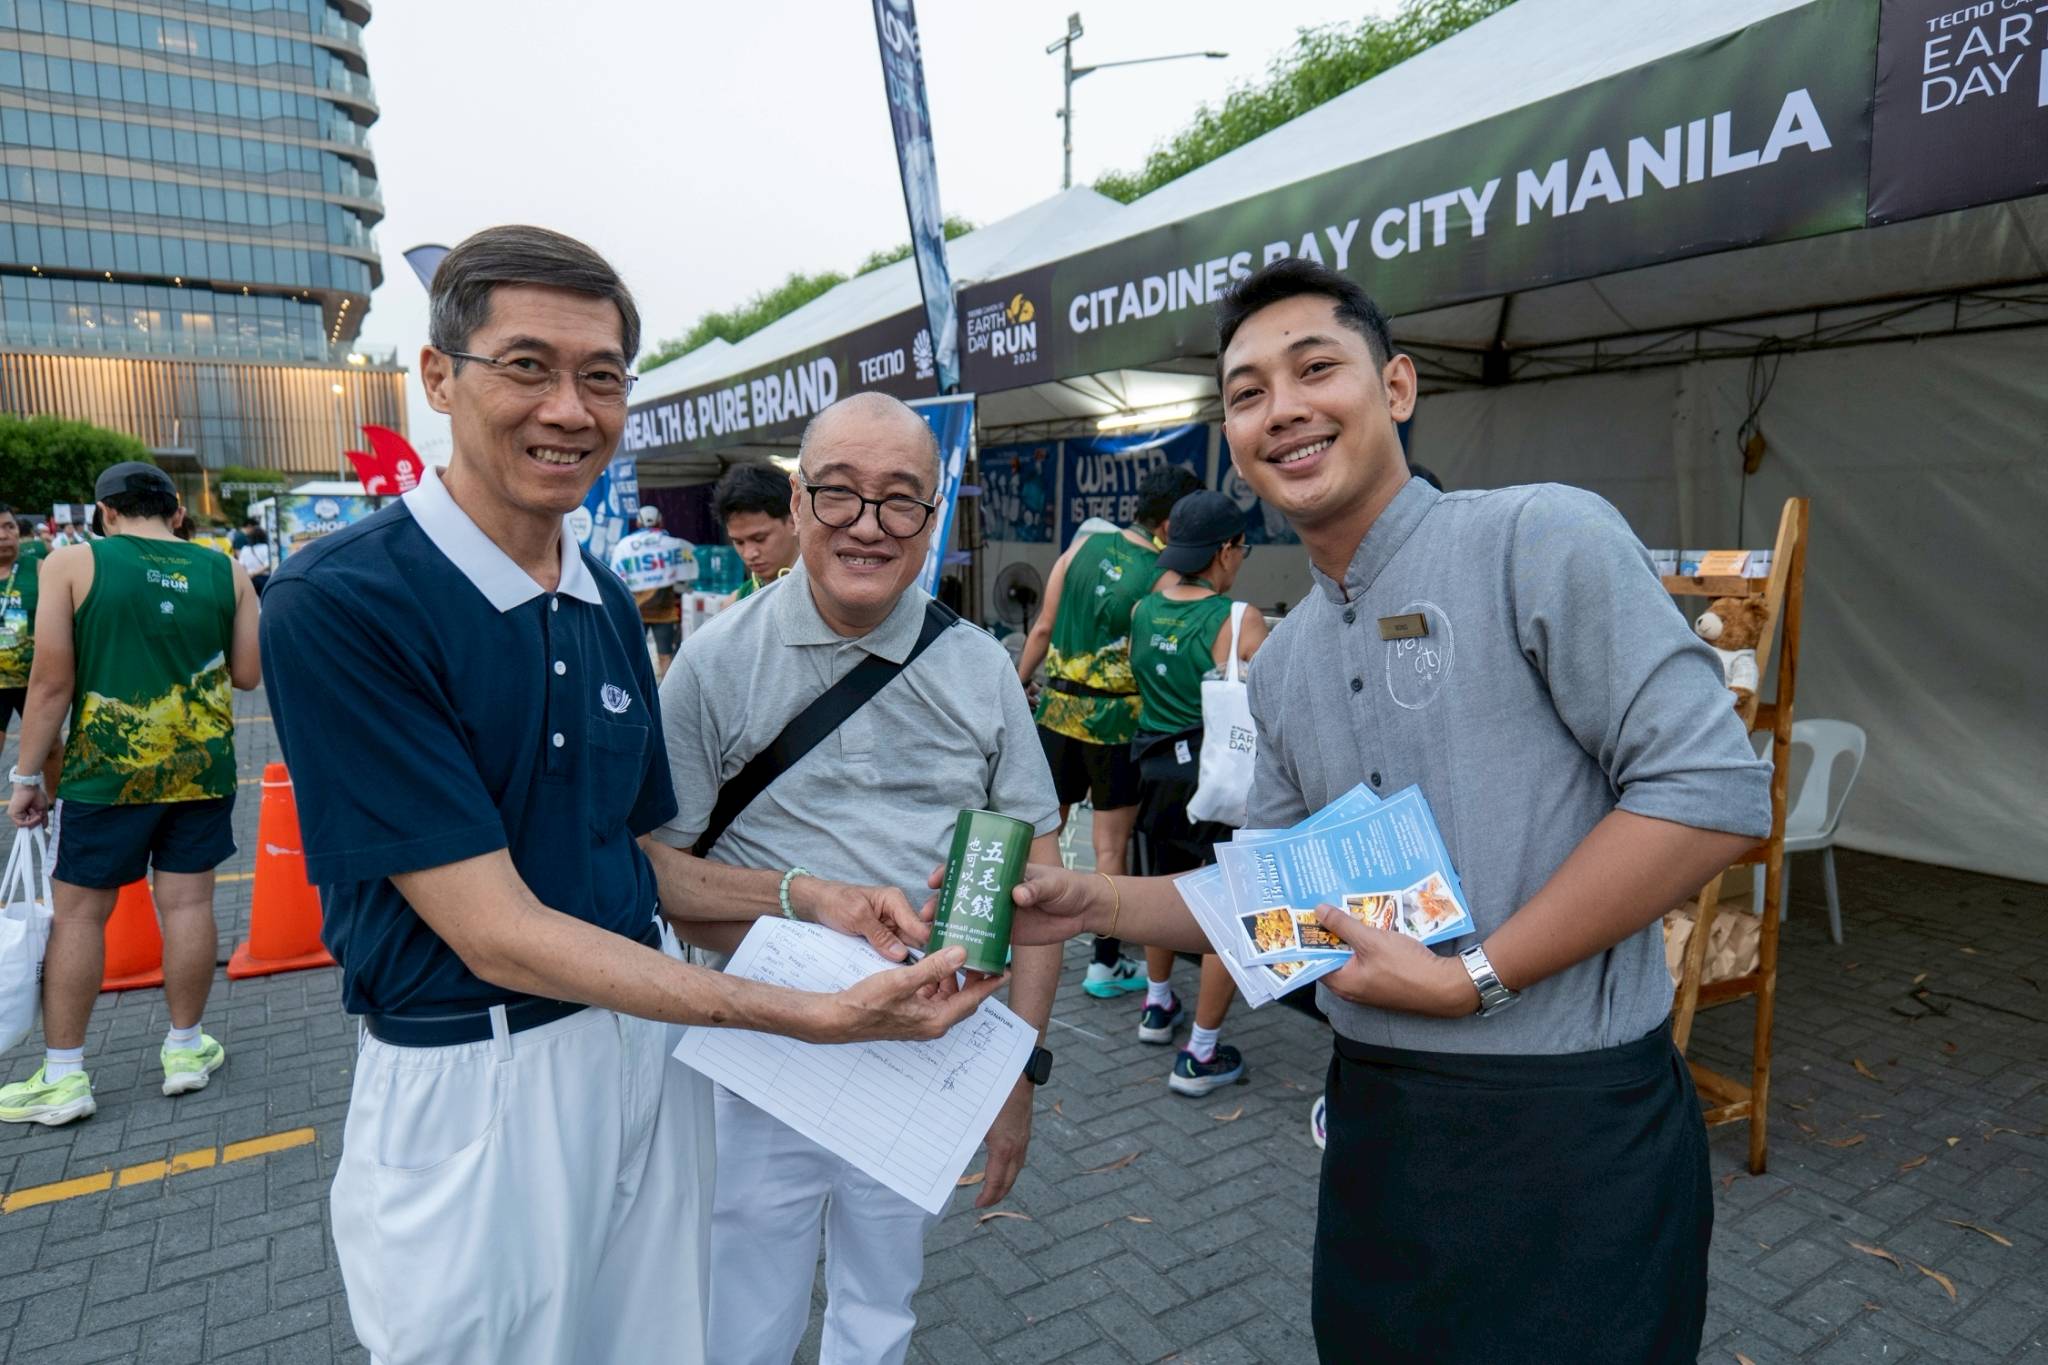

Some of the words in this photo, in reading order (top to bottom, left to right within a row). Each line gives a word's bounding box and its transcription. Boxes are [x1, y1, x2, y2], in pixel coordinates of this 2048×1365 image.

[1926, 1, 1994, 33] TECNO
[1923, 5, 2048, 75] EAR
[1921, 53, 2024, 115] DAY
[1069, 250, 1253, 335] CITADINES
[1371, 179, 1500, 260] CITY
[1516, 88, 1833, 227] MANILA
[967, 310, 1006, 337] EARTH
[968, 332, 990, 354] DAY
[992, 321, 1037, 357] RUN
[858, 348, 905, 384] TECNO
[1013, 350, 1037, 366] 2026
[624, 403, 683, 451] HEALTH
[684, 399, 697, 440] &
[698, 384, 749, 438] PURE
[751, 356, 838, 427] BRAND
[161, 579, 189, 590] RUN
[1229, 740, 1252, 754] DAY
[953, 836, 984, 915] 也可以救人
[970, 841, 1004, 922] 五毛錢
[965, 935, 983, 945] lives.
[969, 928, 996, 939] amount
